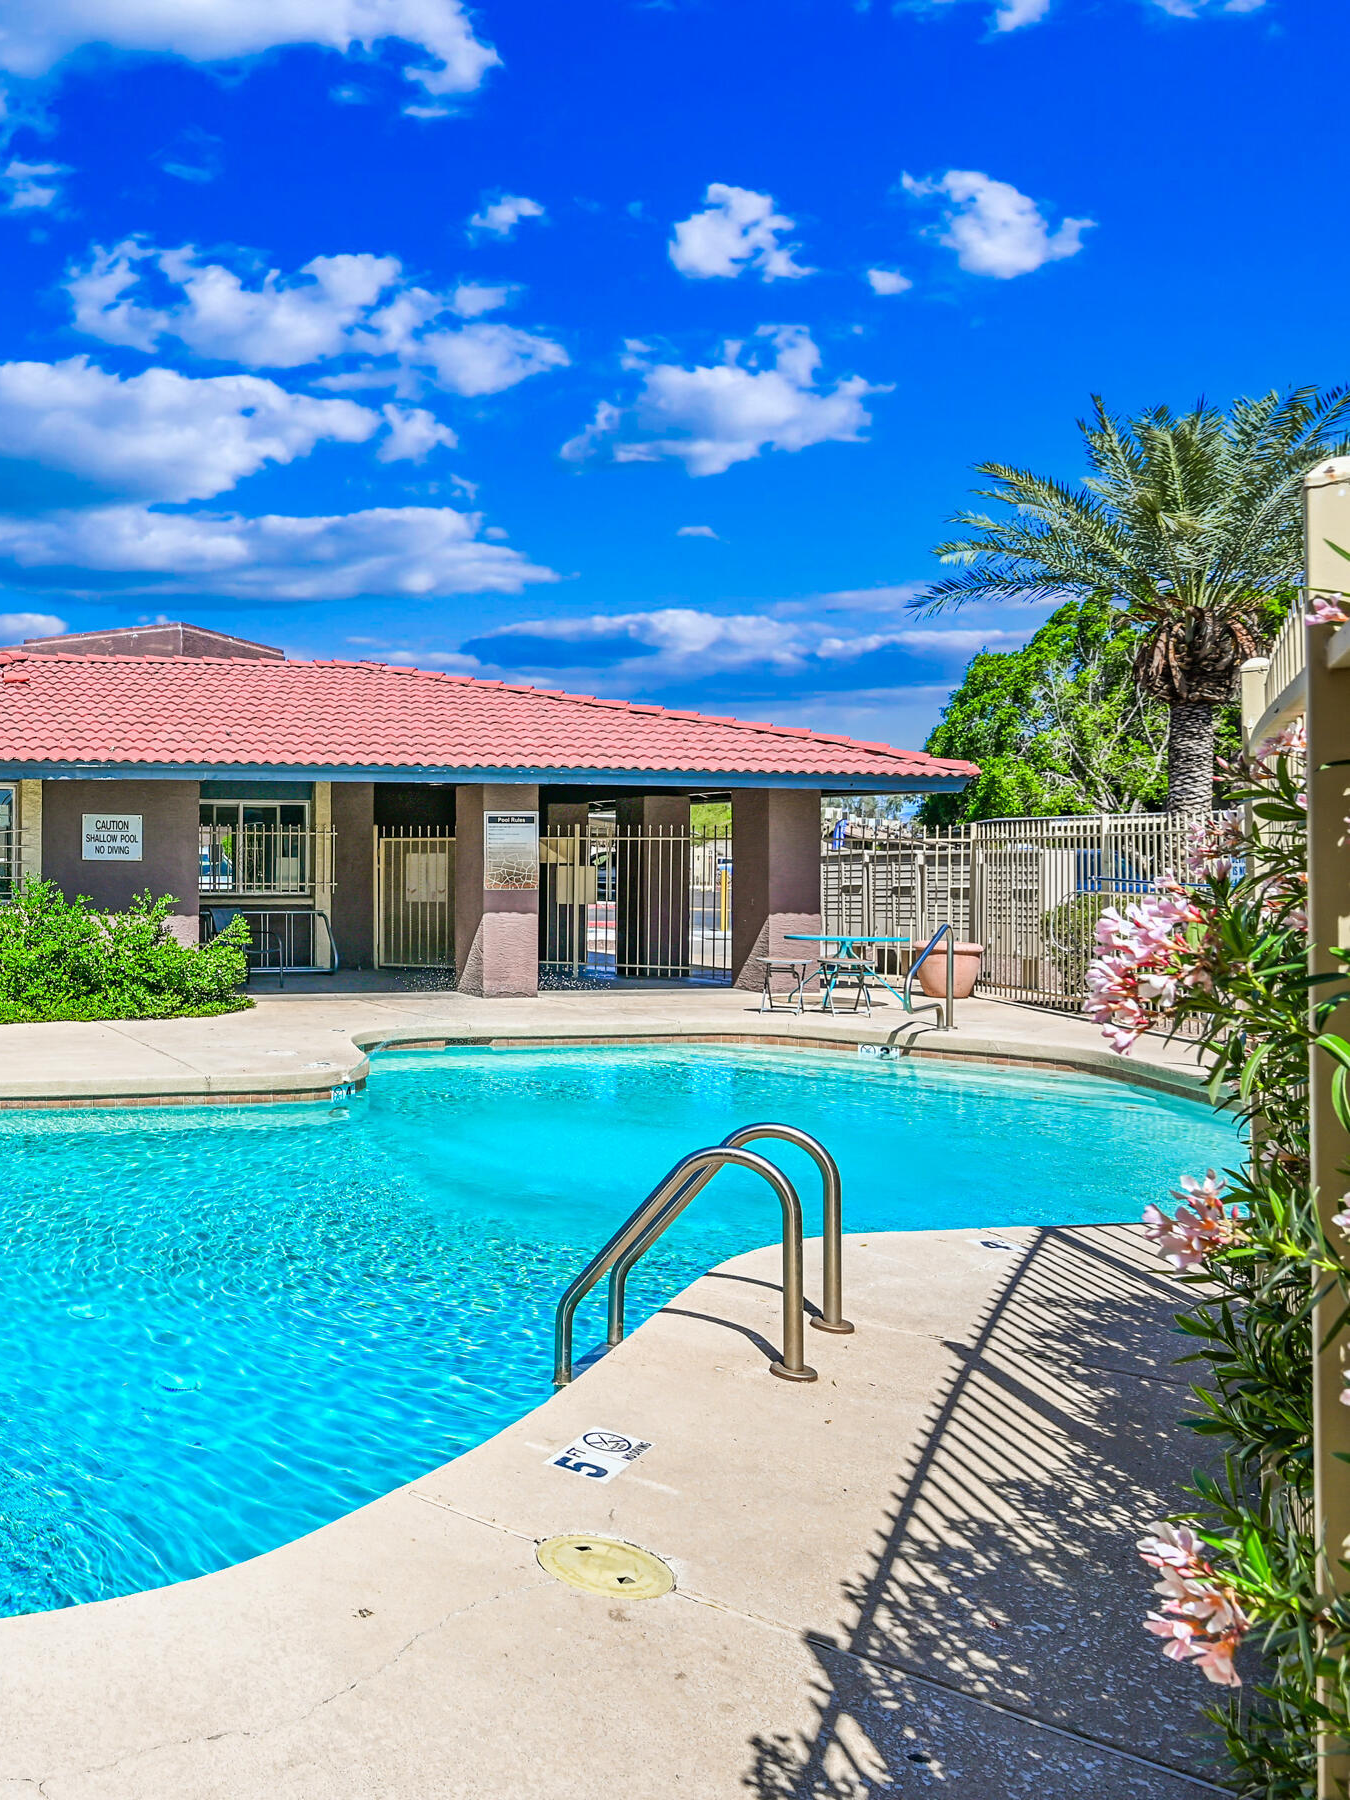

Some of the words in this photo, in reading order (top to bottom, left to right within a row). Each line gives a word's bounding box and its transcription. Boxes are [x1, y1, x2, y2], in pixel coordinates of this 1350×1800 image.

[95, 820, 129, 830] CAUTION
[86, 834, 118, 843] SHALLOW
[121, 835, 139, 843] POOL
[95, 846, 105, 854] NO
[108, 846, 130, 855] DIVING
[566, 1447, 587, 1458] FT
[553, 1456, 608, 1478] 5
